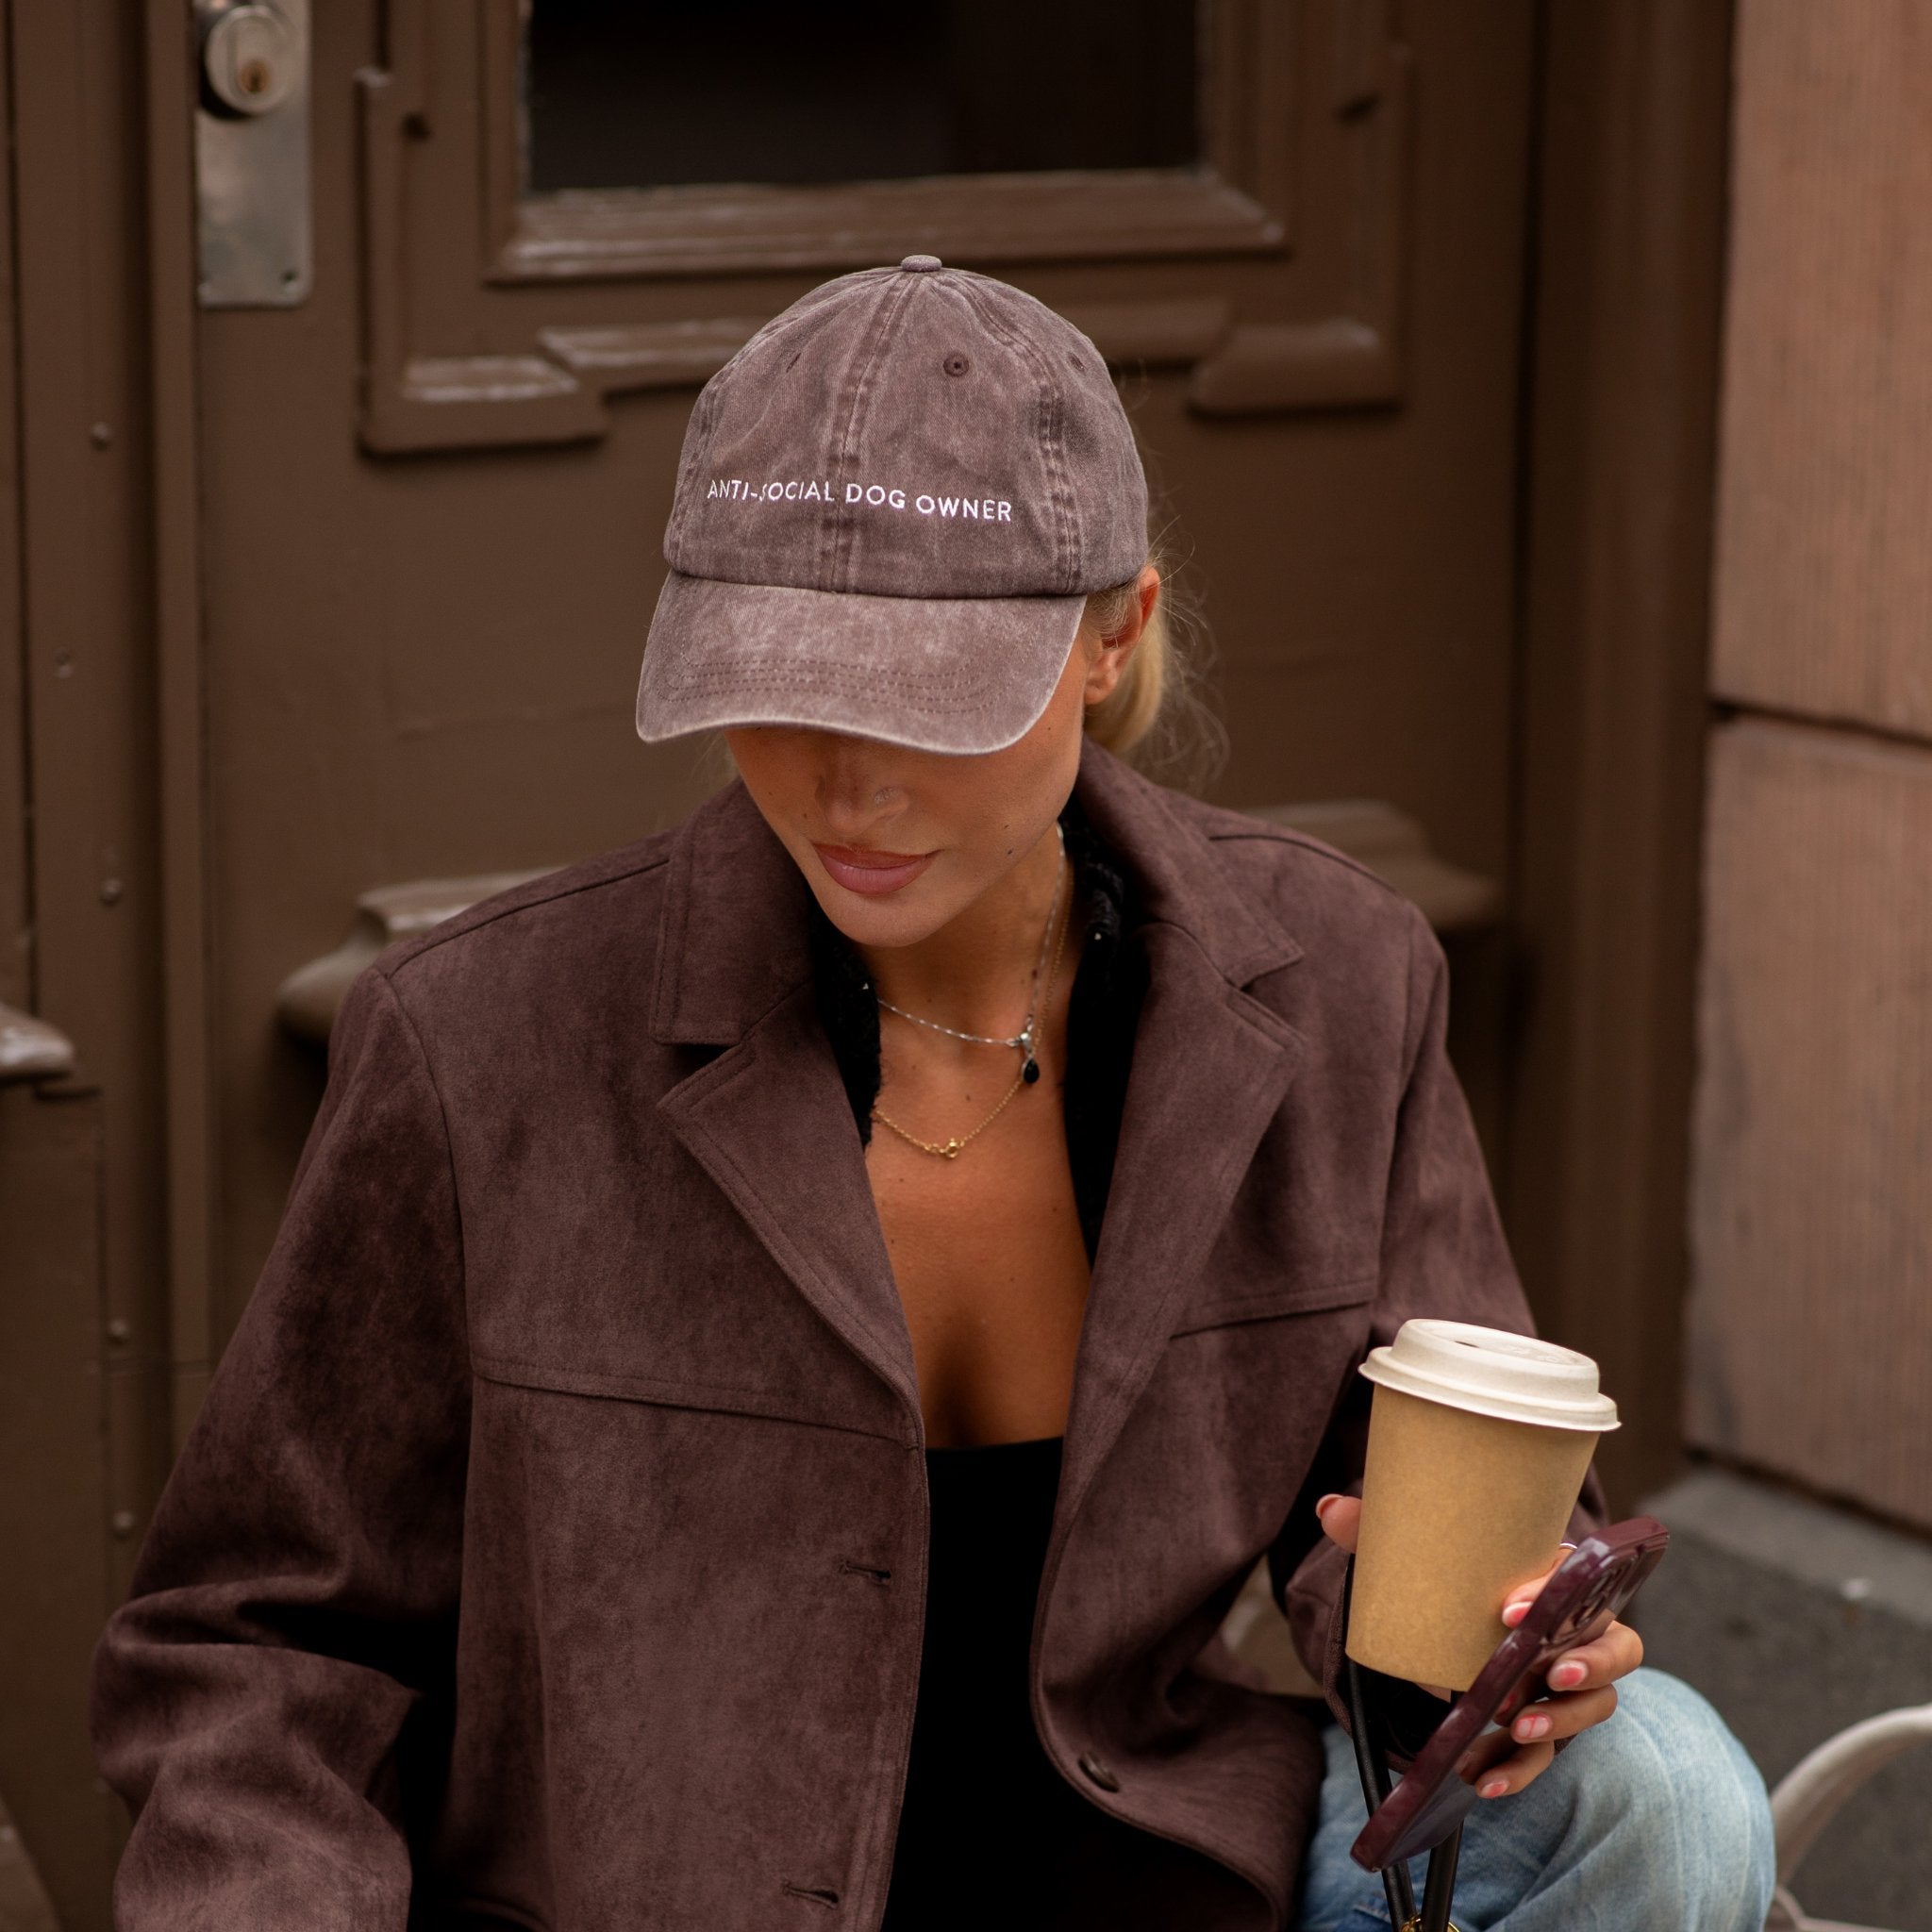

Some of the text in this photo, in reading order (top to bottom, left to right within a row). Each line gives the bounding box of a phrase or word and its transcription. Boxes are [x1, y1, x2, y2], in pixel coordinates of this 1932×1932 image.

[707, 479, 1013, 523] ANTI-SOCIAL DOG OWNER
